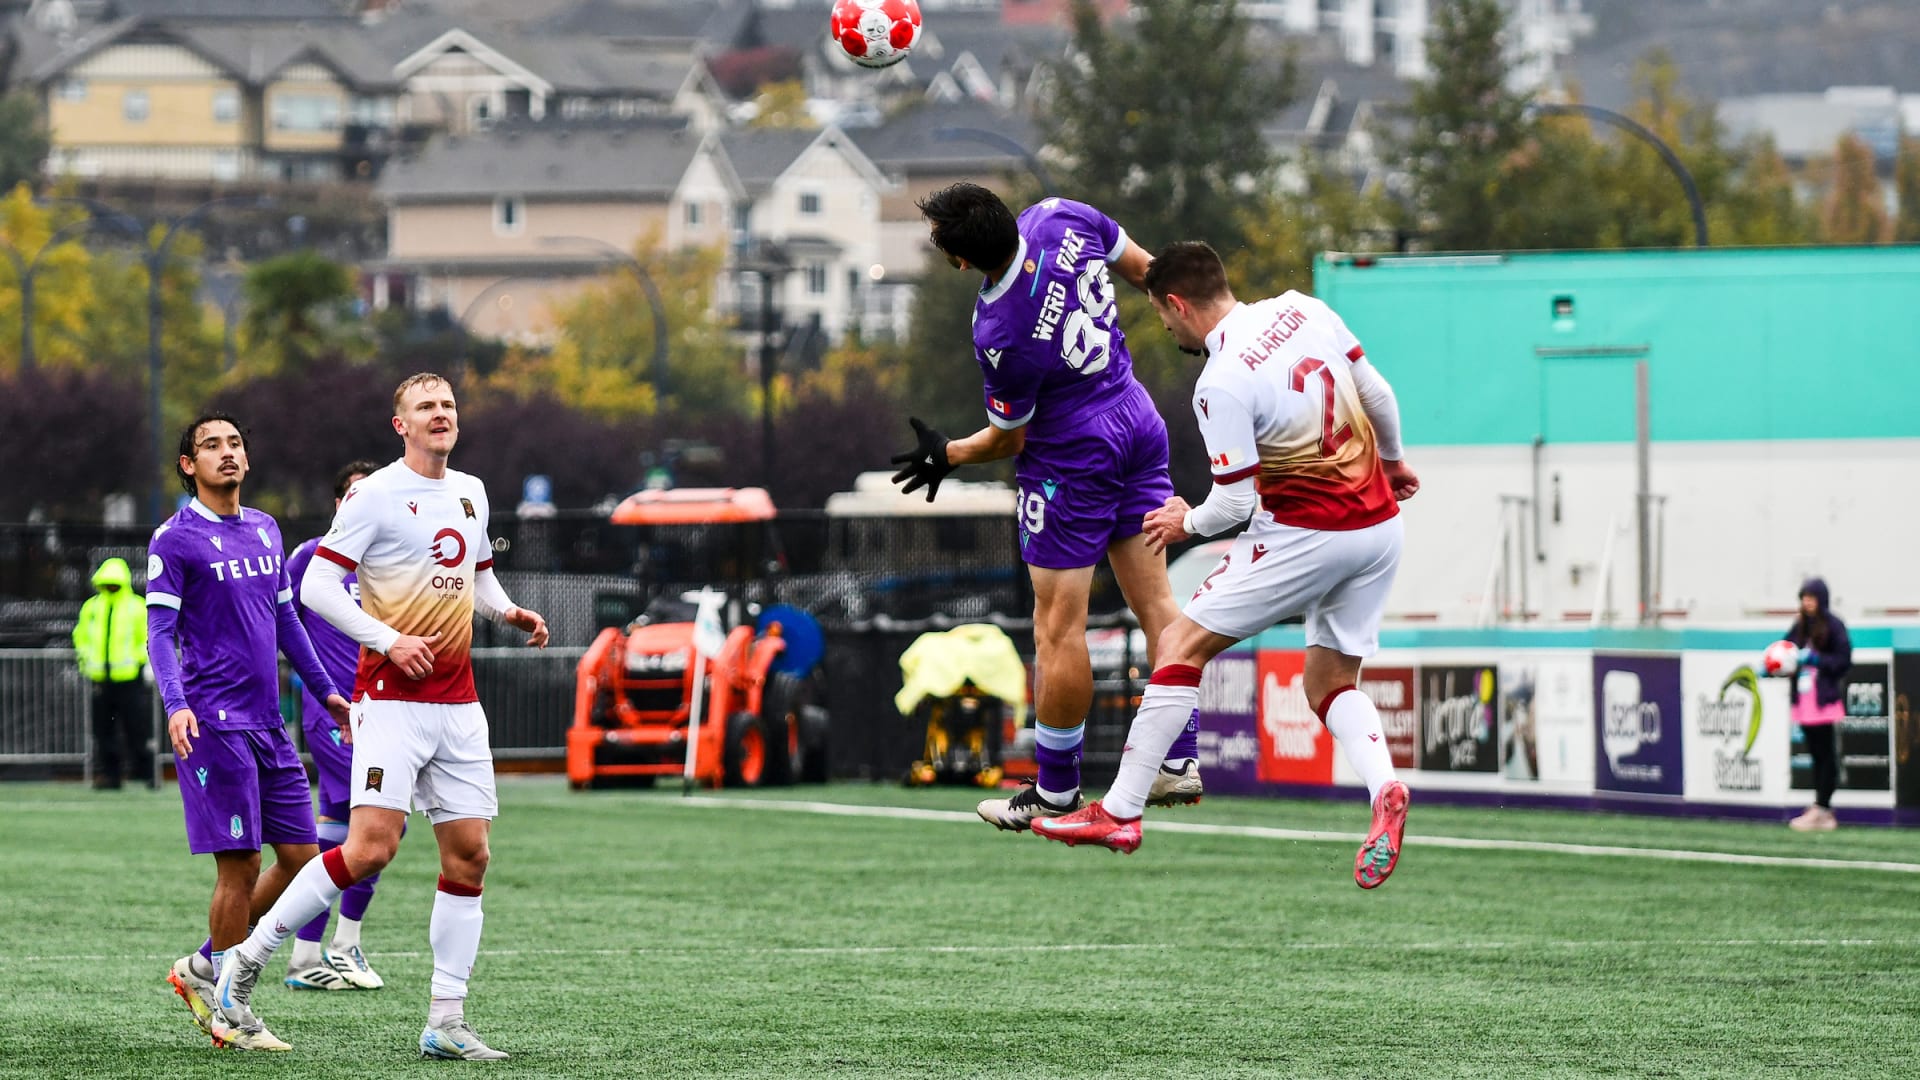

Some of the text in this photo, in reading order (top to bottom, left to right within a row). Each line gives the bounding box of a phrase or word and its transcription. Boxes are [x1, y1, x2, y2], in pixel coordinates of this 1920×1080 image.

[1031, 280, 1067, 341] WERD
[1060, 259, 1117, 375] 99
[1287, 354, 1354, 459] 2
[431, 575, 464, 591] one
